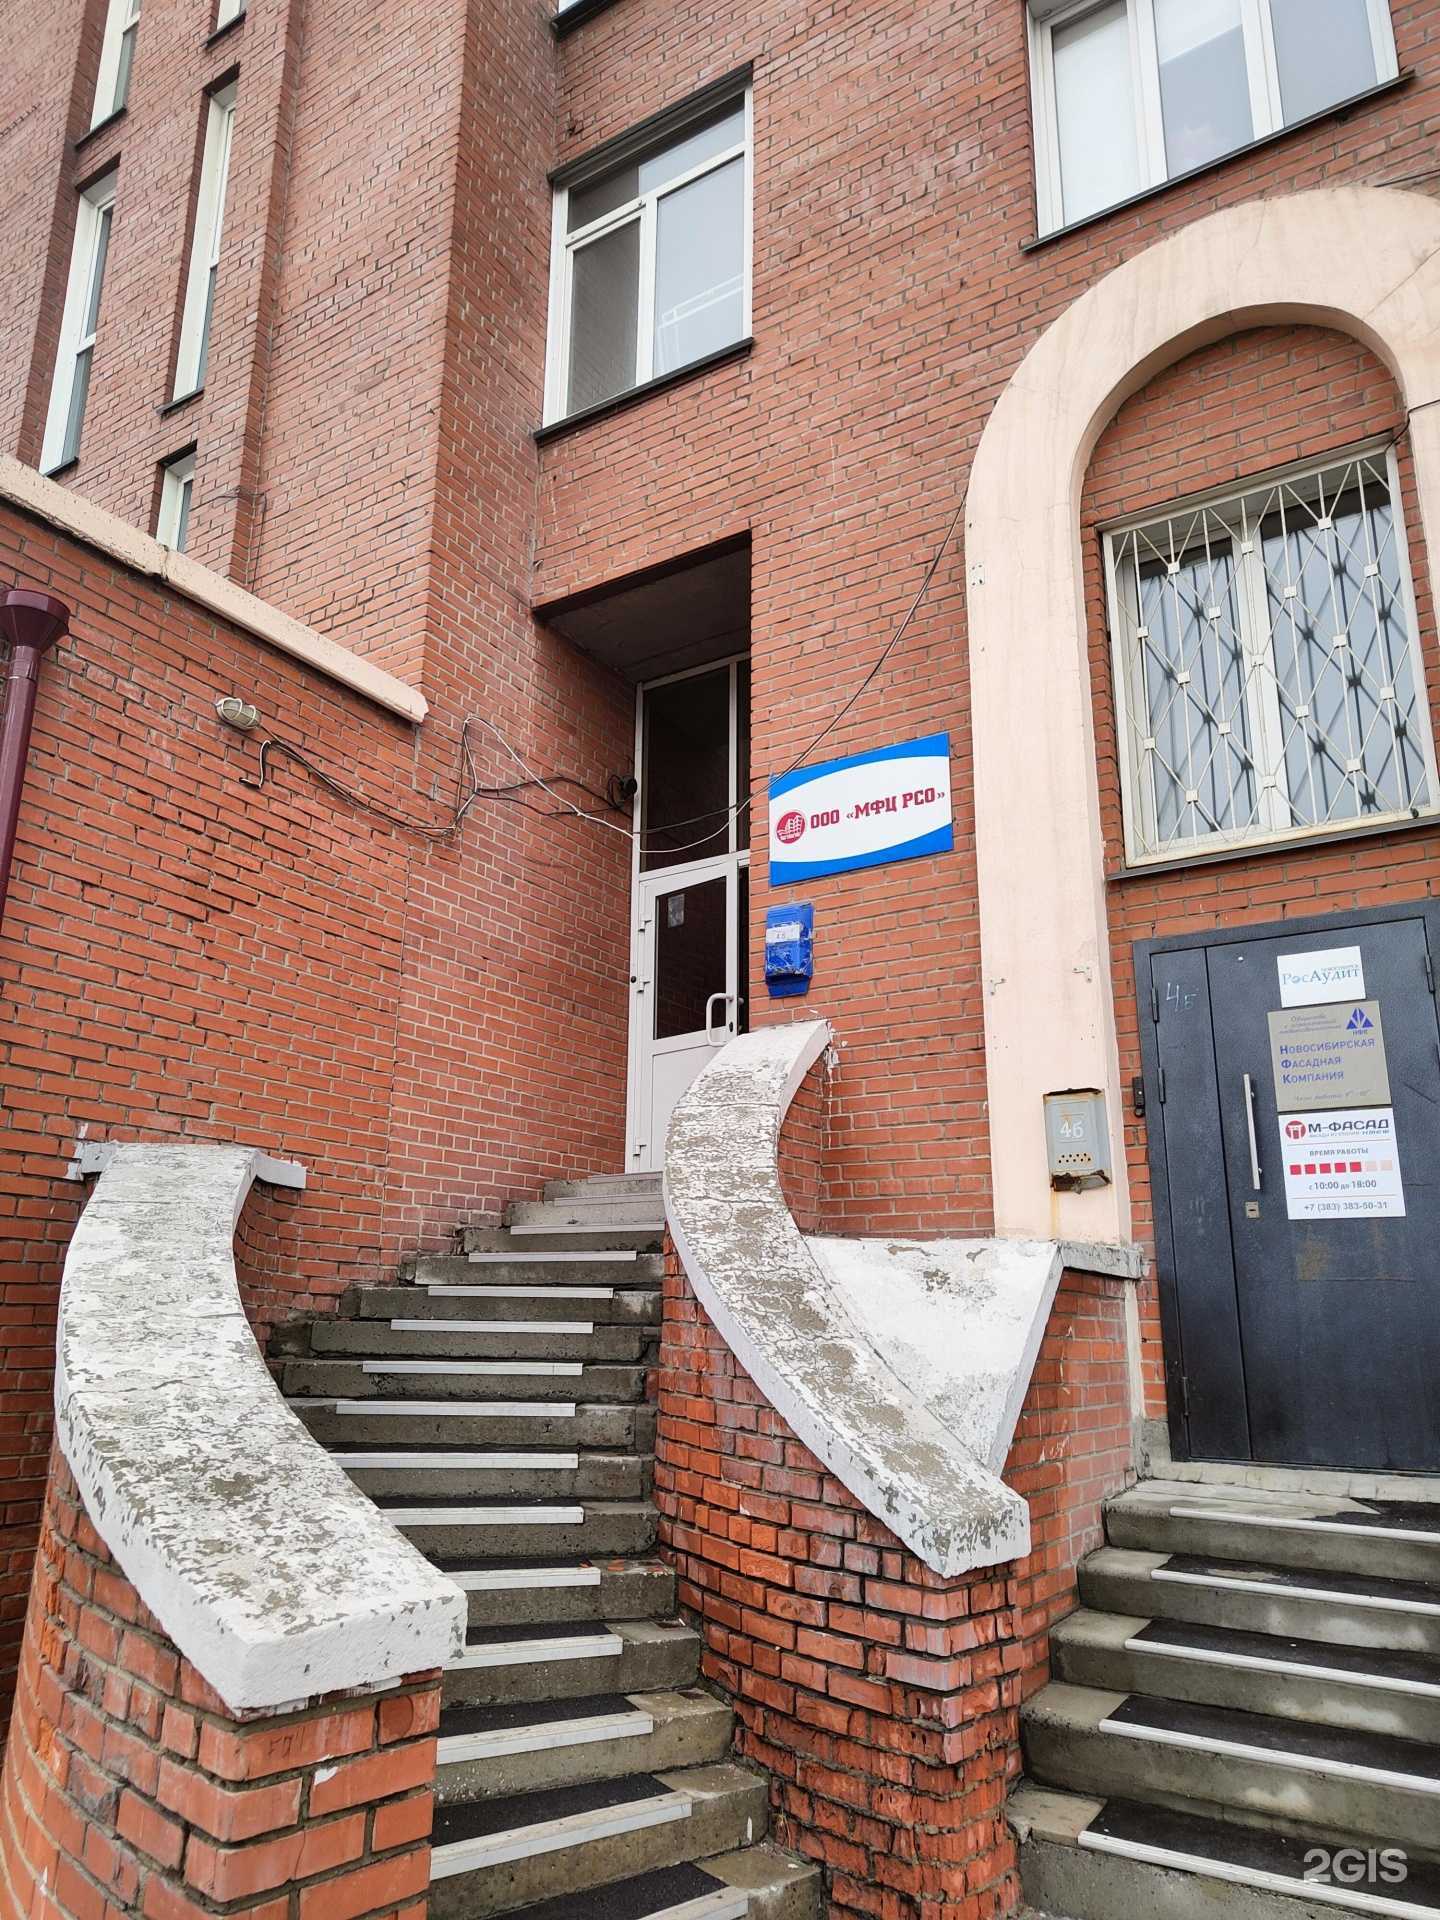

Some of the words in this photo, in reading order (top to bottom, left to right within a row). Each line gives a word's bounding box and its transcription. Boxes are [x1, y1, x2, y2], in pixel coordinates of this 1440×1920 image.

[810, 809, 840, 829] ООО
[846, 796, 898, 819] «МФЦ
[902, 787, 945, 809] РСО»
[1308, 1119, 1390, 1134] М-ФАСАД
[1314, 1181, 1339, 1190] 10:00
